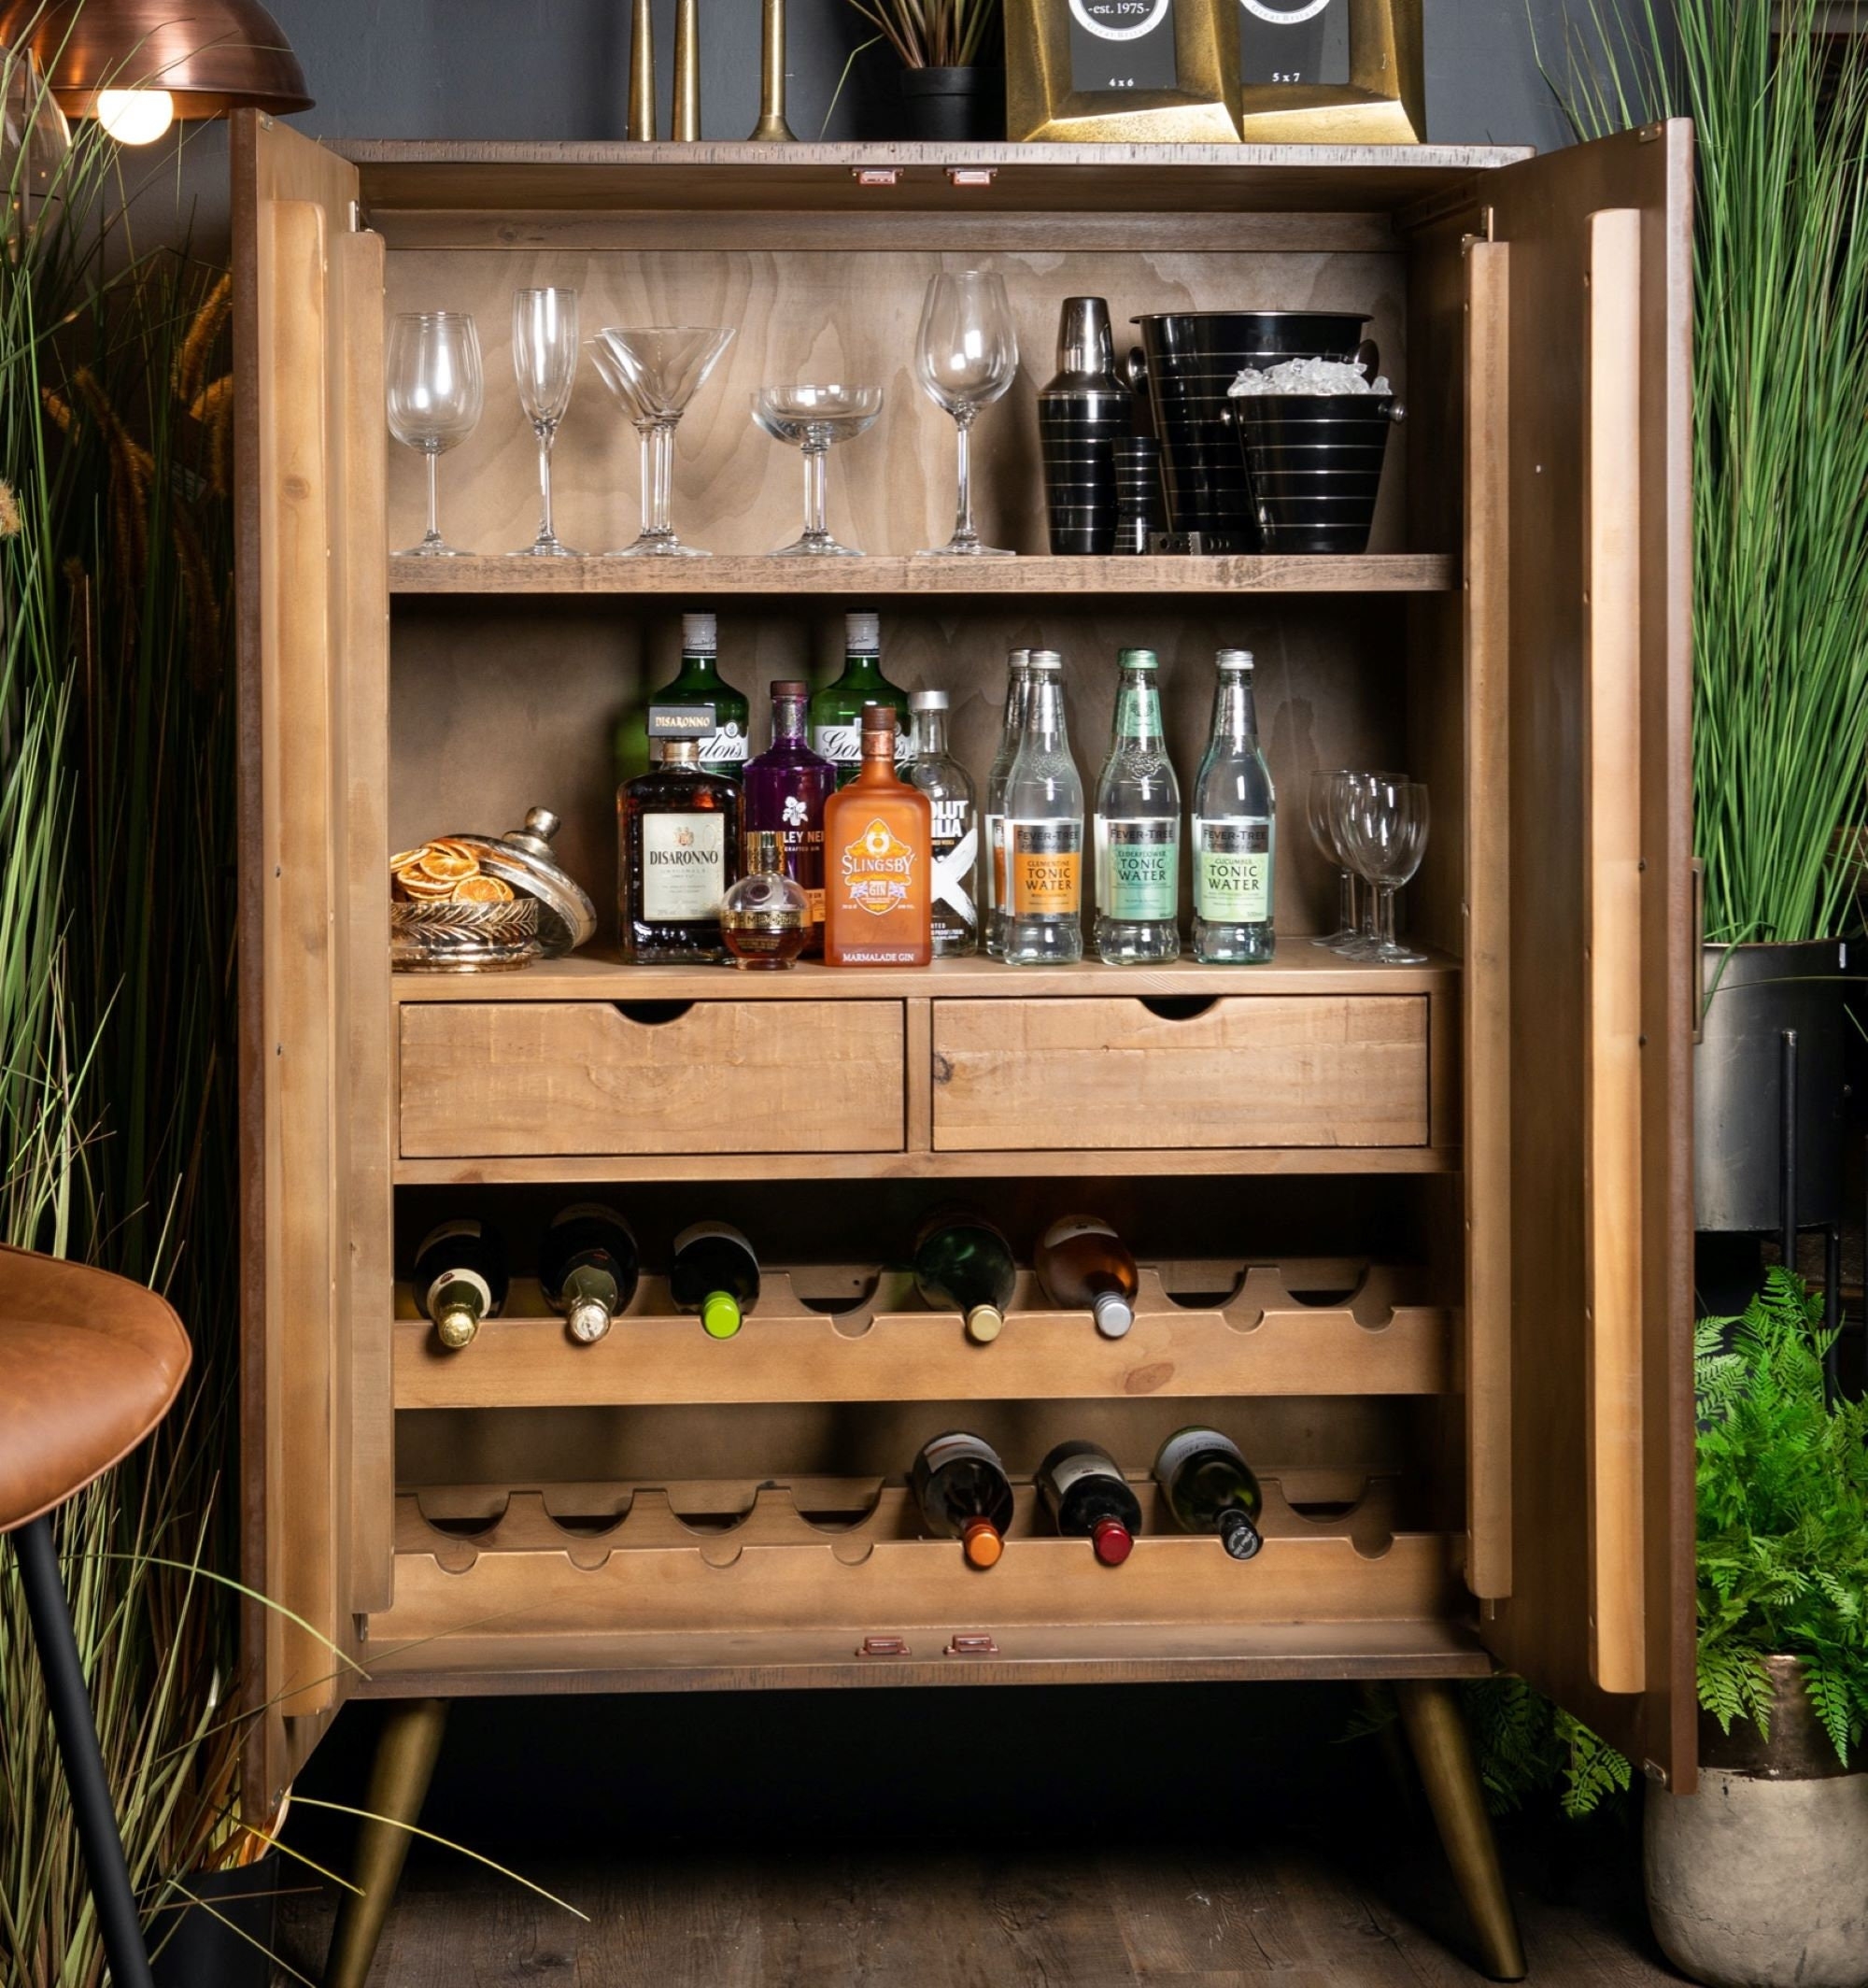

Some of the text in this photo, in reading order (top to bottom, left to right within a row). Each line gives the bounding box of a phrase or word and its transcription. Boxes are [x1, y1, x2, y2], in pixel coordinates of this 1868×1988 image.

[1109, 78, 1116, 87] 4
[1126, 78, 1134, 87] 6
[1272, 72, 1280, 82] 5
[1293, 72, 1300, 82] 7
[655, 717, 711, 727] DISARONNO
[1016, 829, 1080, 840] FEVER-TREE
[1111, 828, 1174, 839] FEVER-TREE
[1203, 829, 1267, 840] FEVER-TREE
[649, 849, 718, 867] DISARONNO
[841, 853, 915, 875] SLINGSBY
[1121, 858, 1165, 870] TONIC
[1027, 868, 1070, 879] TONIC
[1117, 870, 1167, 881] WATER
[1209, 865, 1258, 877] TONIC
[1026, 880, 1072, 890] WATER
[1208, 878, 1260, 890] WATER
[869, 884, 886, 897] GIN
[842, 953, 914, 962] MARMALADE GIN
